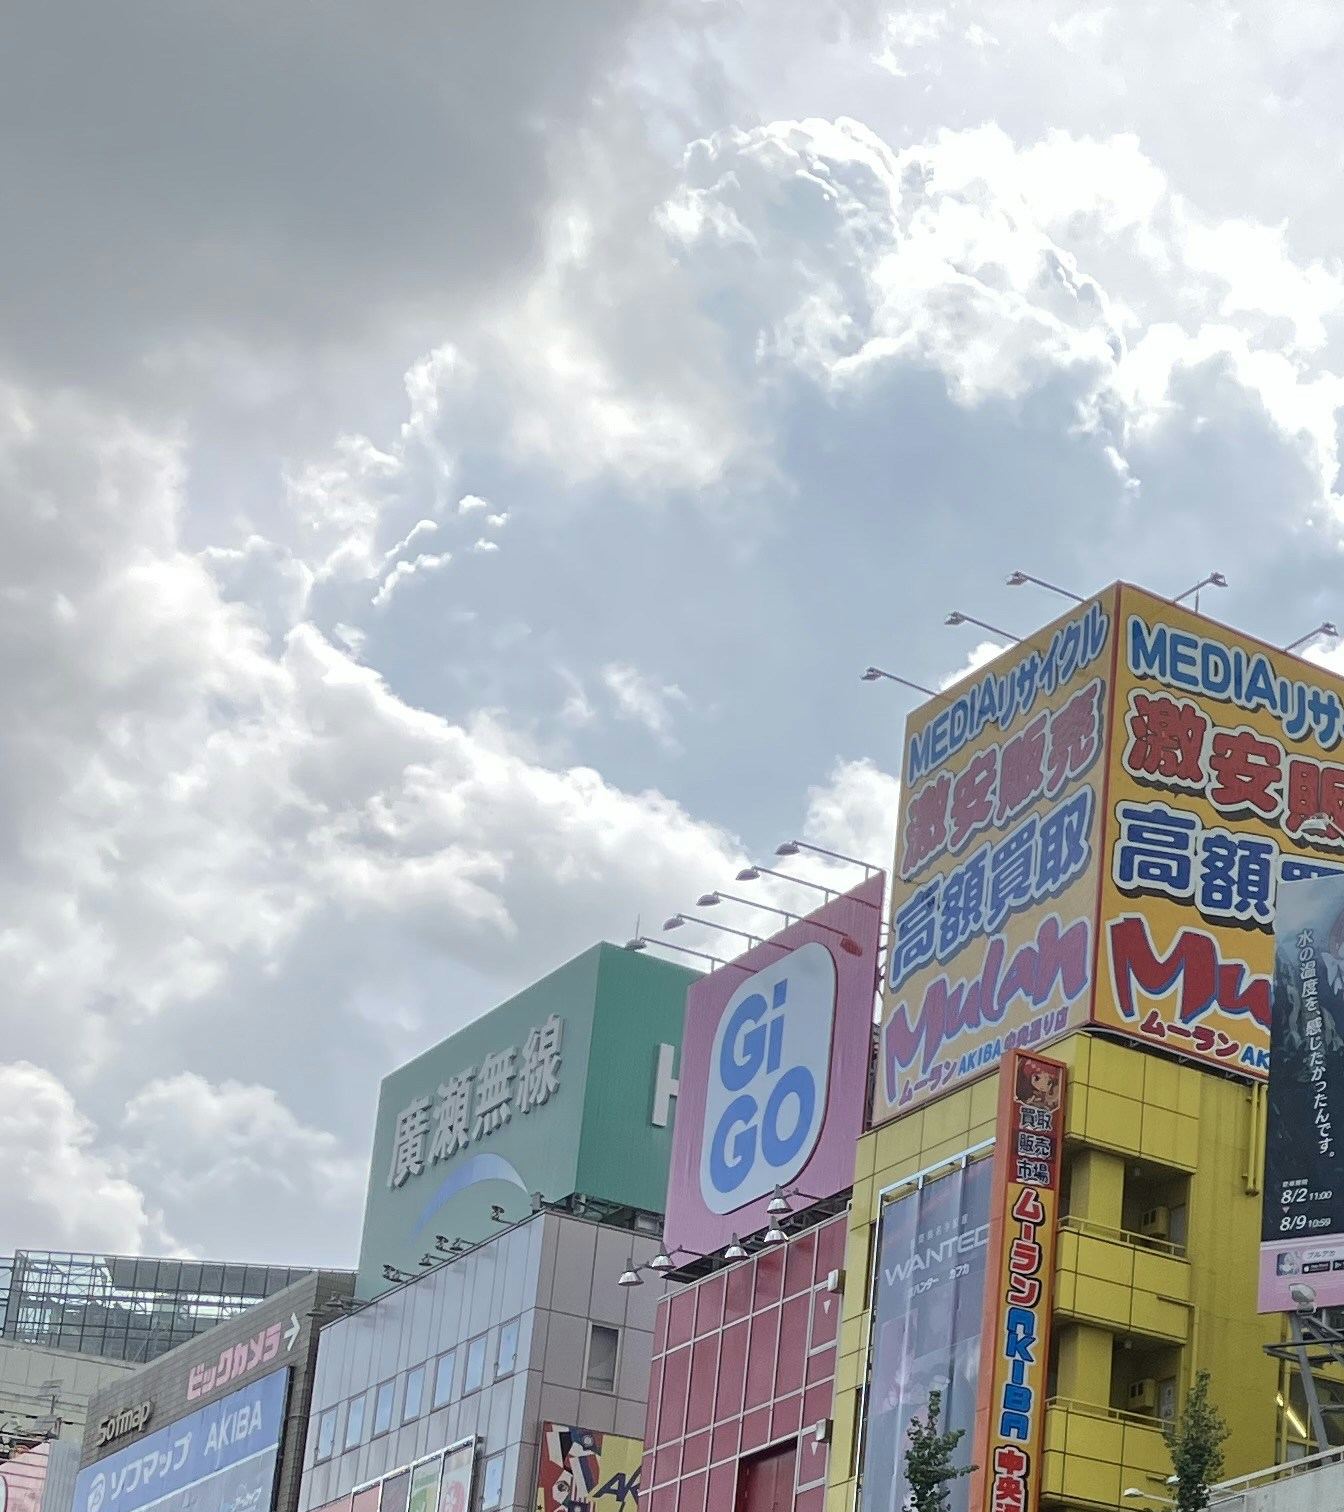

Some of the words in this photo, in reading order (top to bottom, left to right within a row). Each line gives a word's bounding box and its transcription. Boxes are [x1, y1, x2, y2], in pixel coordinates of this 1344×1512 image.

[903, 678, 1101, 875] 激安販売
[891, 786, 1094, 984] 高額買取
[883, 915, 1091, 1086] Mulan
[1018, 1133, 1051, 1157] 販売
[1019, 1106, 1051, 1131] 買取
[1016, 1159, 1050, 1185] 市場
[1280, 1188, 1308, 1204] 8/2
[1279, 1215, 1307, 1231] 8/9
[187, 1322, 282, 1400] ビックカメラ
[204, 1400, 262, 1457] AKIBA
[111, 1432, 192, 1500] ソフマップ
